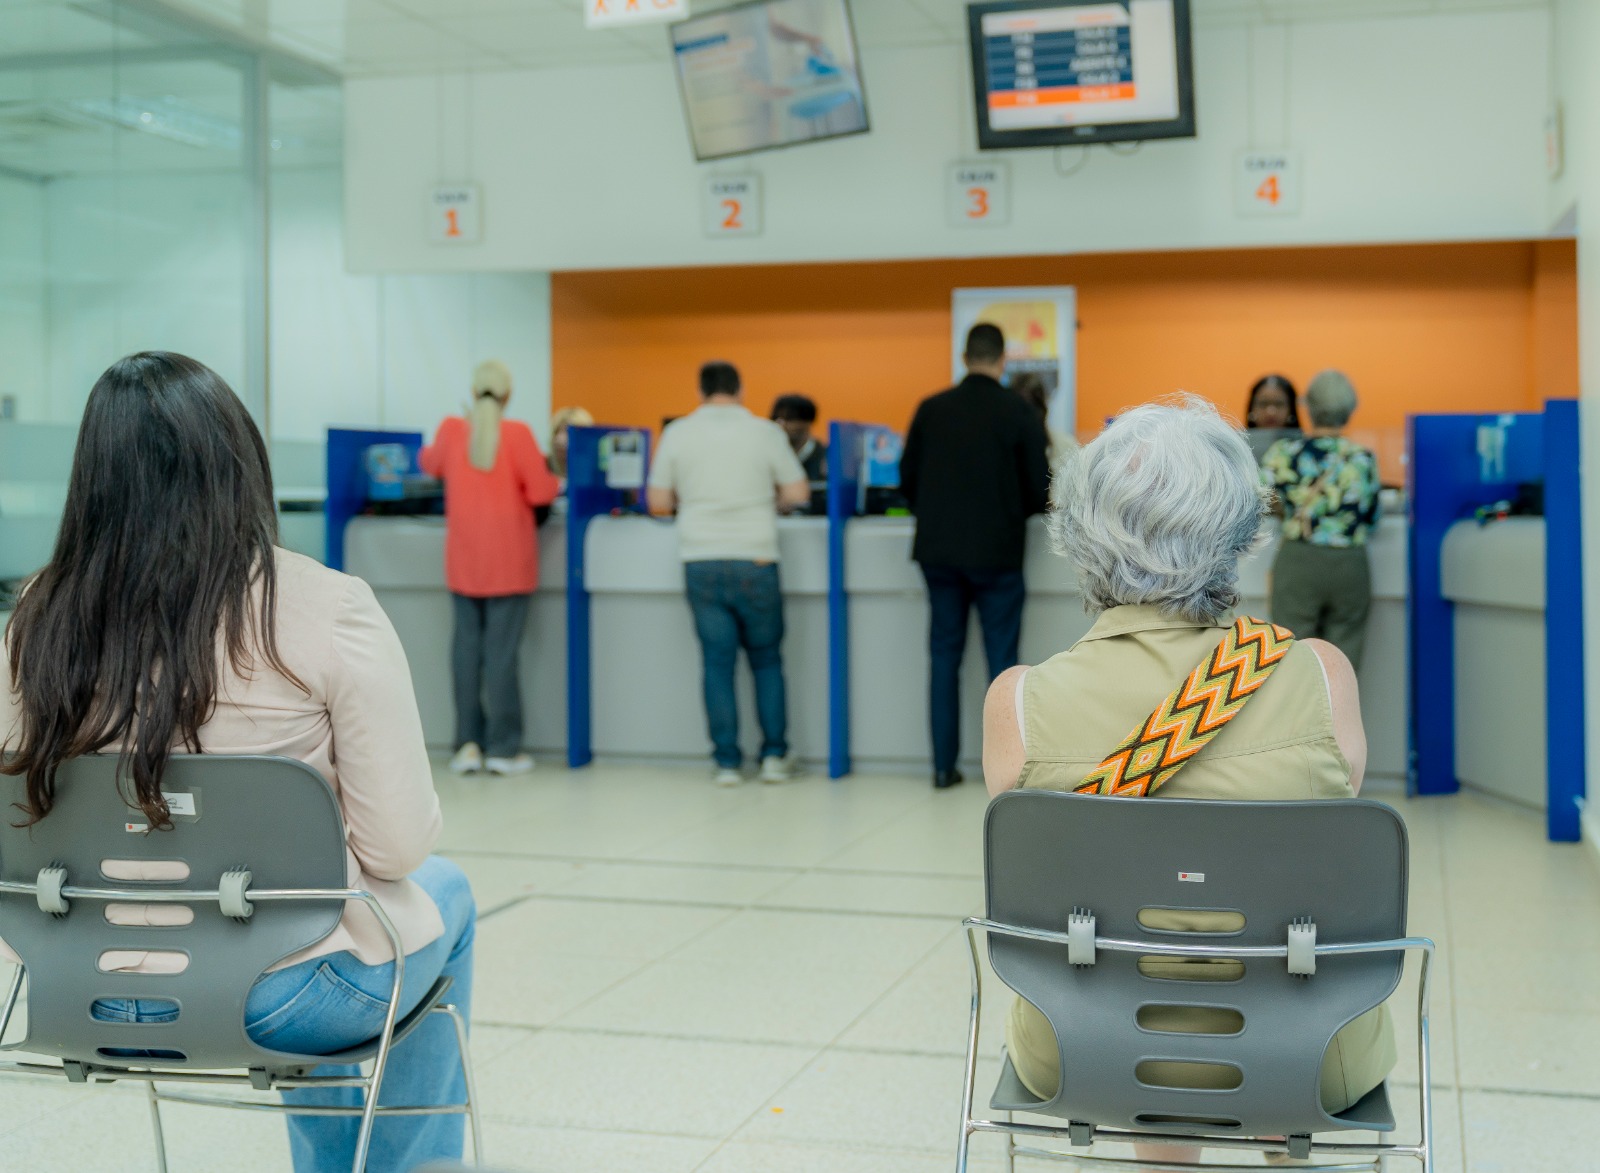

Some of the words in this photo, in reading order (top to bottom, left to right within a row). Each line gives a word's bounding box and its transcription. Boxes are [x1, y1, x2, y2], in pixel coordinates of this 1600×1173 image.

[966, 187, 989, 218] 3
[1255, 175, 1281, 205] 4
[444, 209, 462, 237] 1
[721, 200, 742, 229] 2
